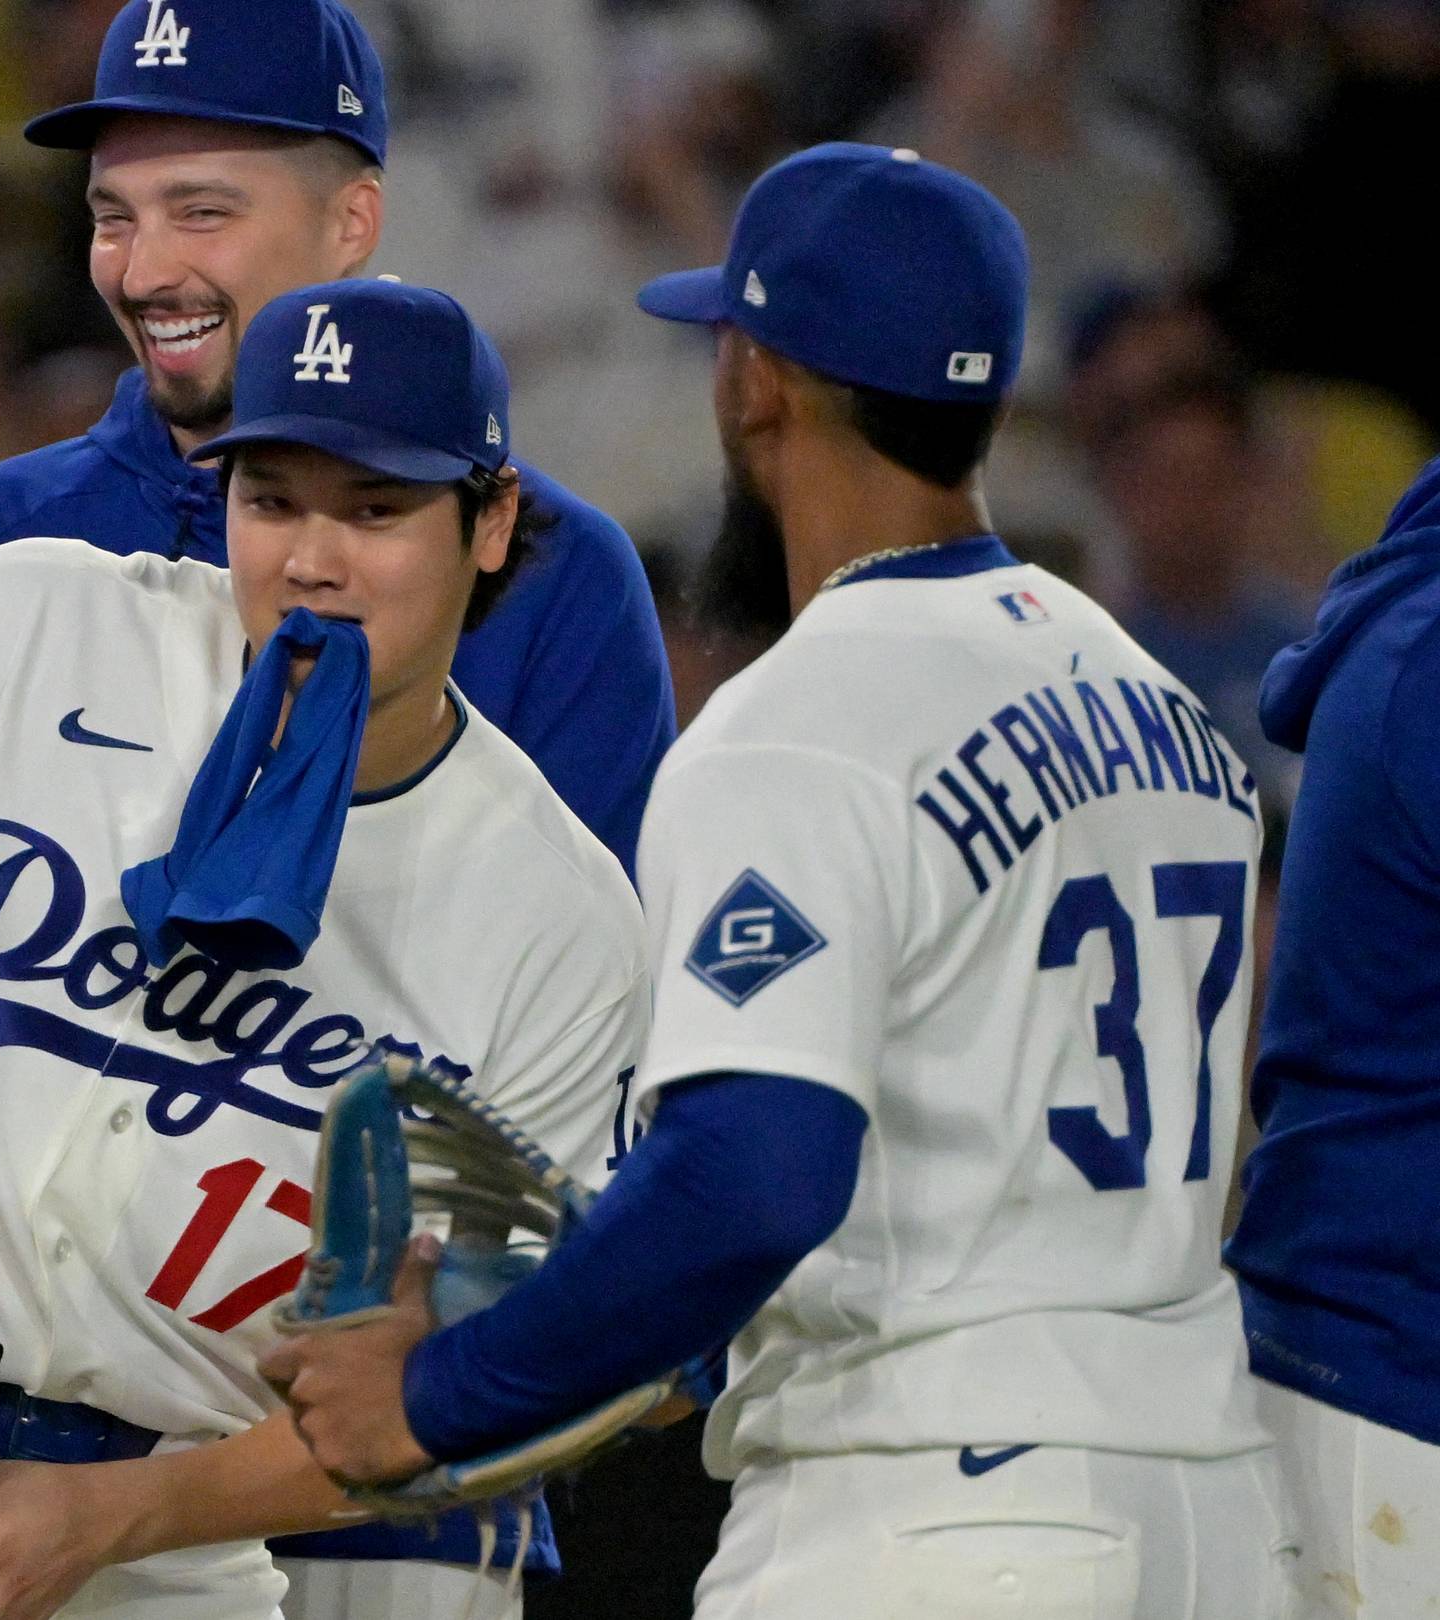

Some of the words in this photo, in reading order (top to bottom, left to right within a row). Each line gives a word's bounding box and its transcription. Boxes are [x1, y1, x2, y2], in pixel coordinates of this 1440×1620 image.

[134, 0, 191, 68] LA
[293, 304, 354, 384] LA
[915, 652, 1257, 896] HERNÁNDE
[1038, 860, 1248, 1192] 37
